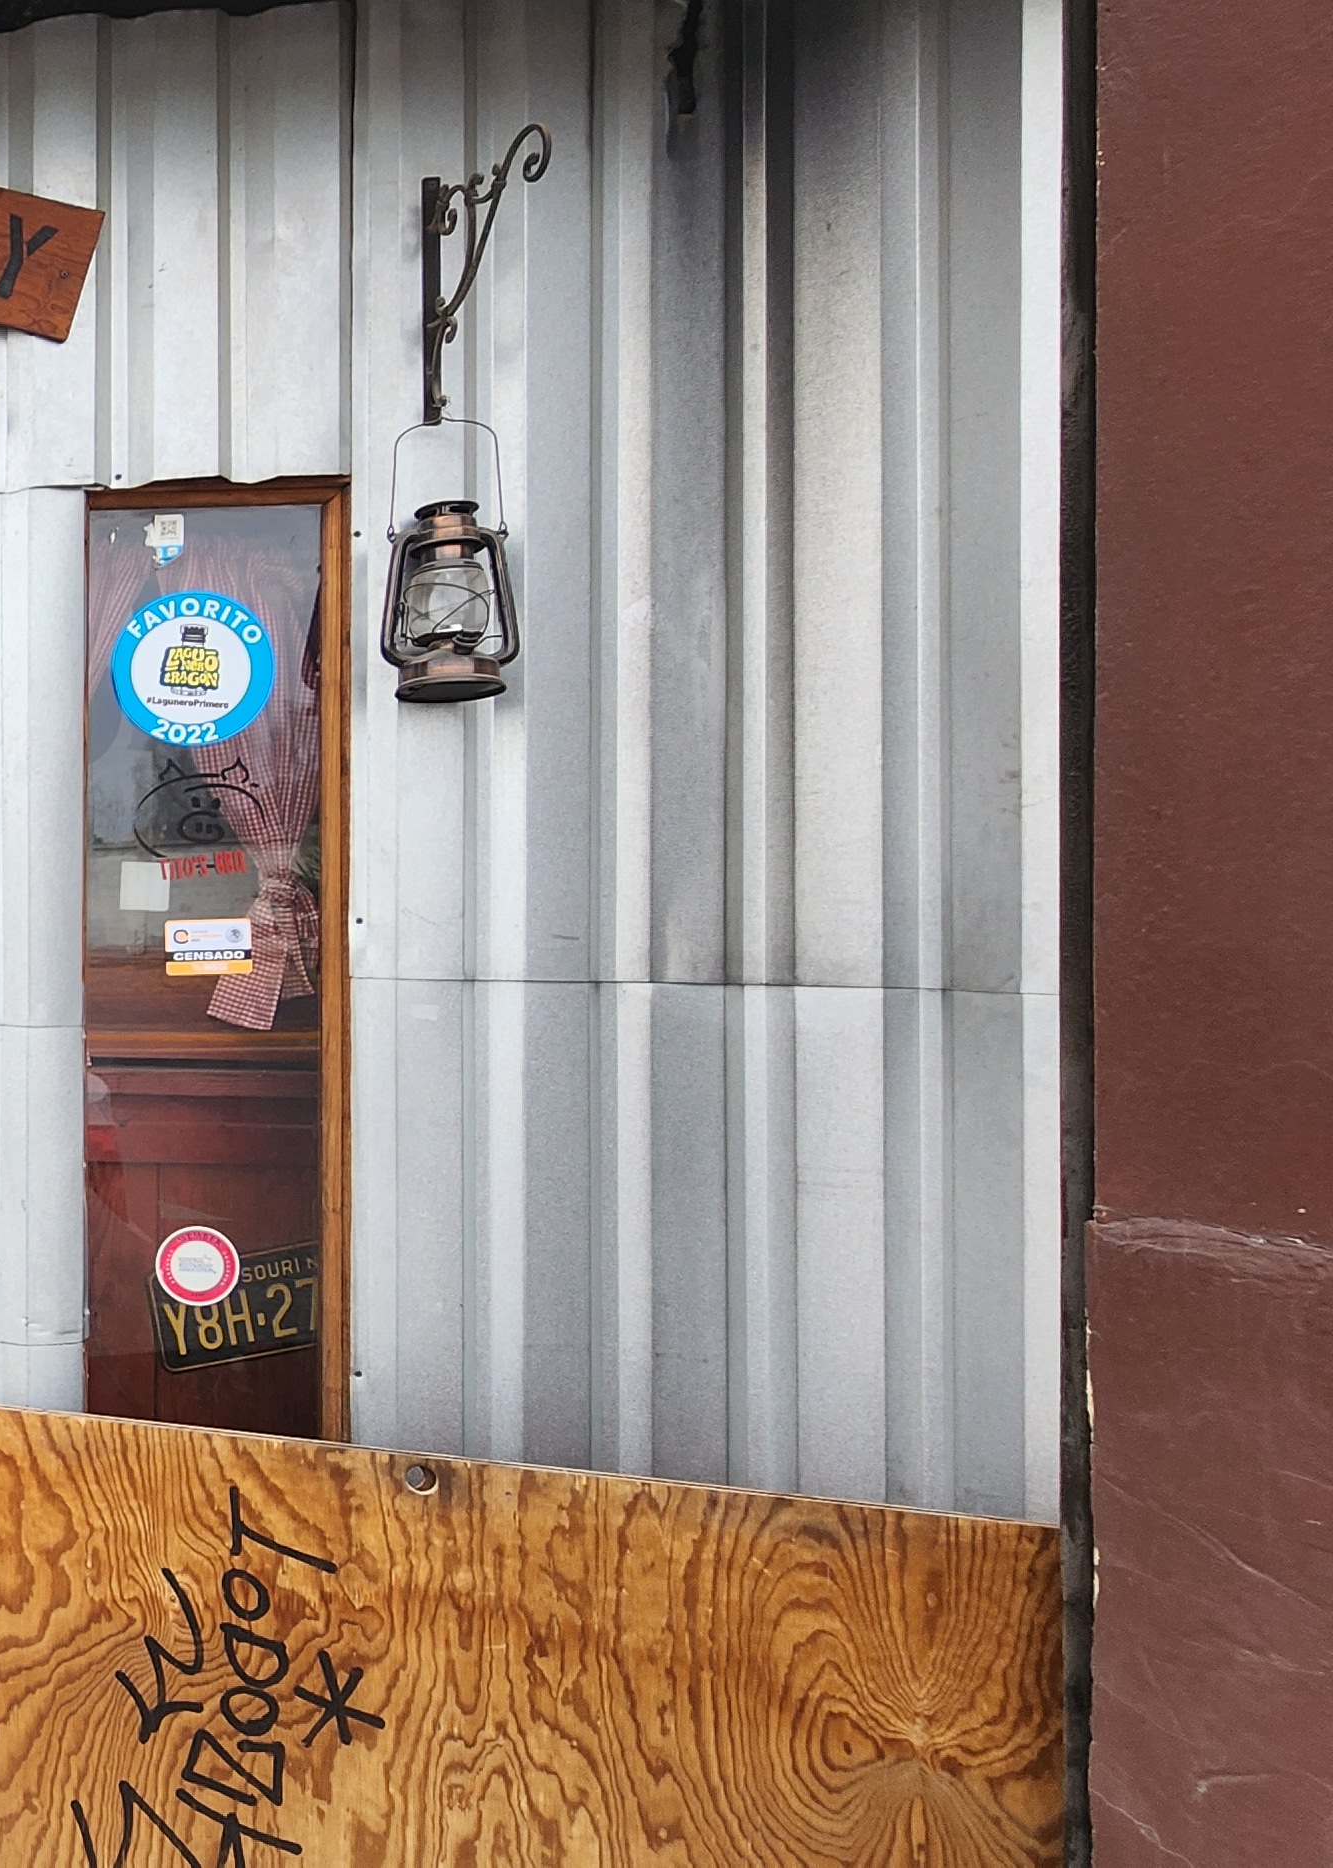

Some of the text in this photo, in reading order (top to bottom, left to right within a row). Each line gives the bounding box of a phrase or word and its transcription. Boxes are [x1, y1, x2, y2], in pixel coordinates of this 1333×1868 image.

[125, 597, 263, 645] FAVORITO
[150, 718, 220, 745] 2022
[215, 849, 248, 875] BBQ
[173, 950, 245, 961] CENSADO
[241, 1258, 301, 1283] SOURI
